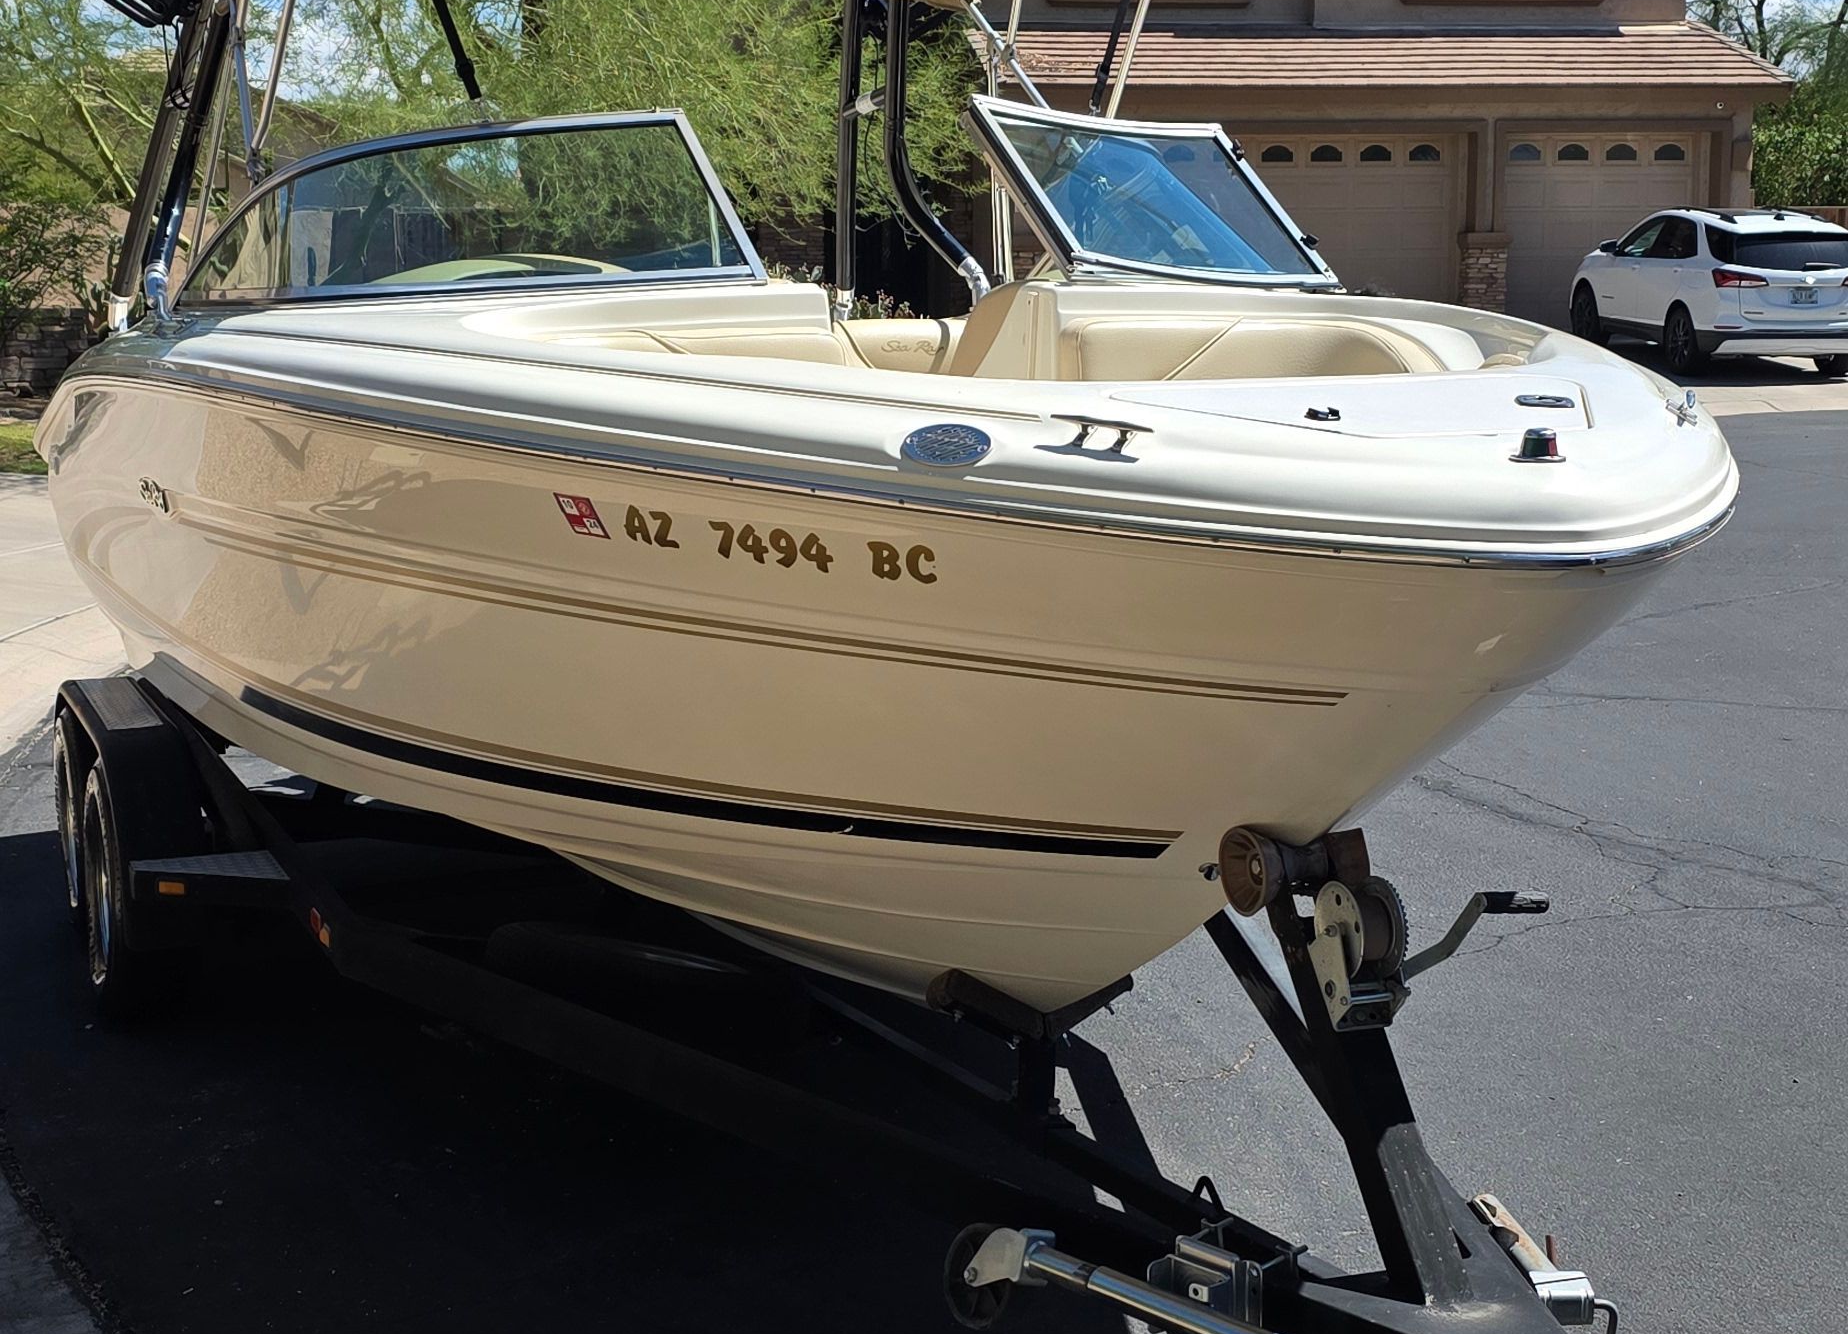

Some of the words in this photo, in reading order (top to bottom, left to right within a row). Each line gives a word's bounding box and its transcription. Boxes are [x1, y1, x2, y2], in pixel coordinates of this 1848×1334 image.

[586, 519, 600, 529] 24
[623, 504, 680, 549] AZ
[708, 520, 834, 573] 7494
[866, 541, 938, 584] BC
